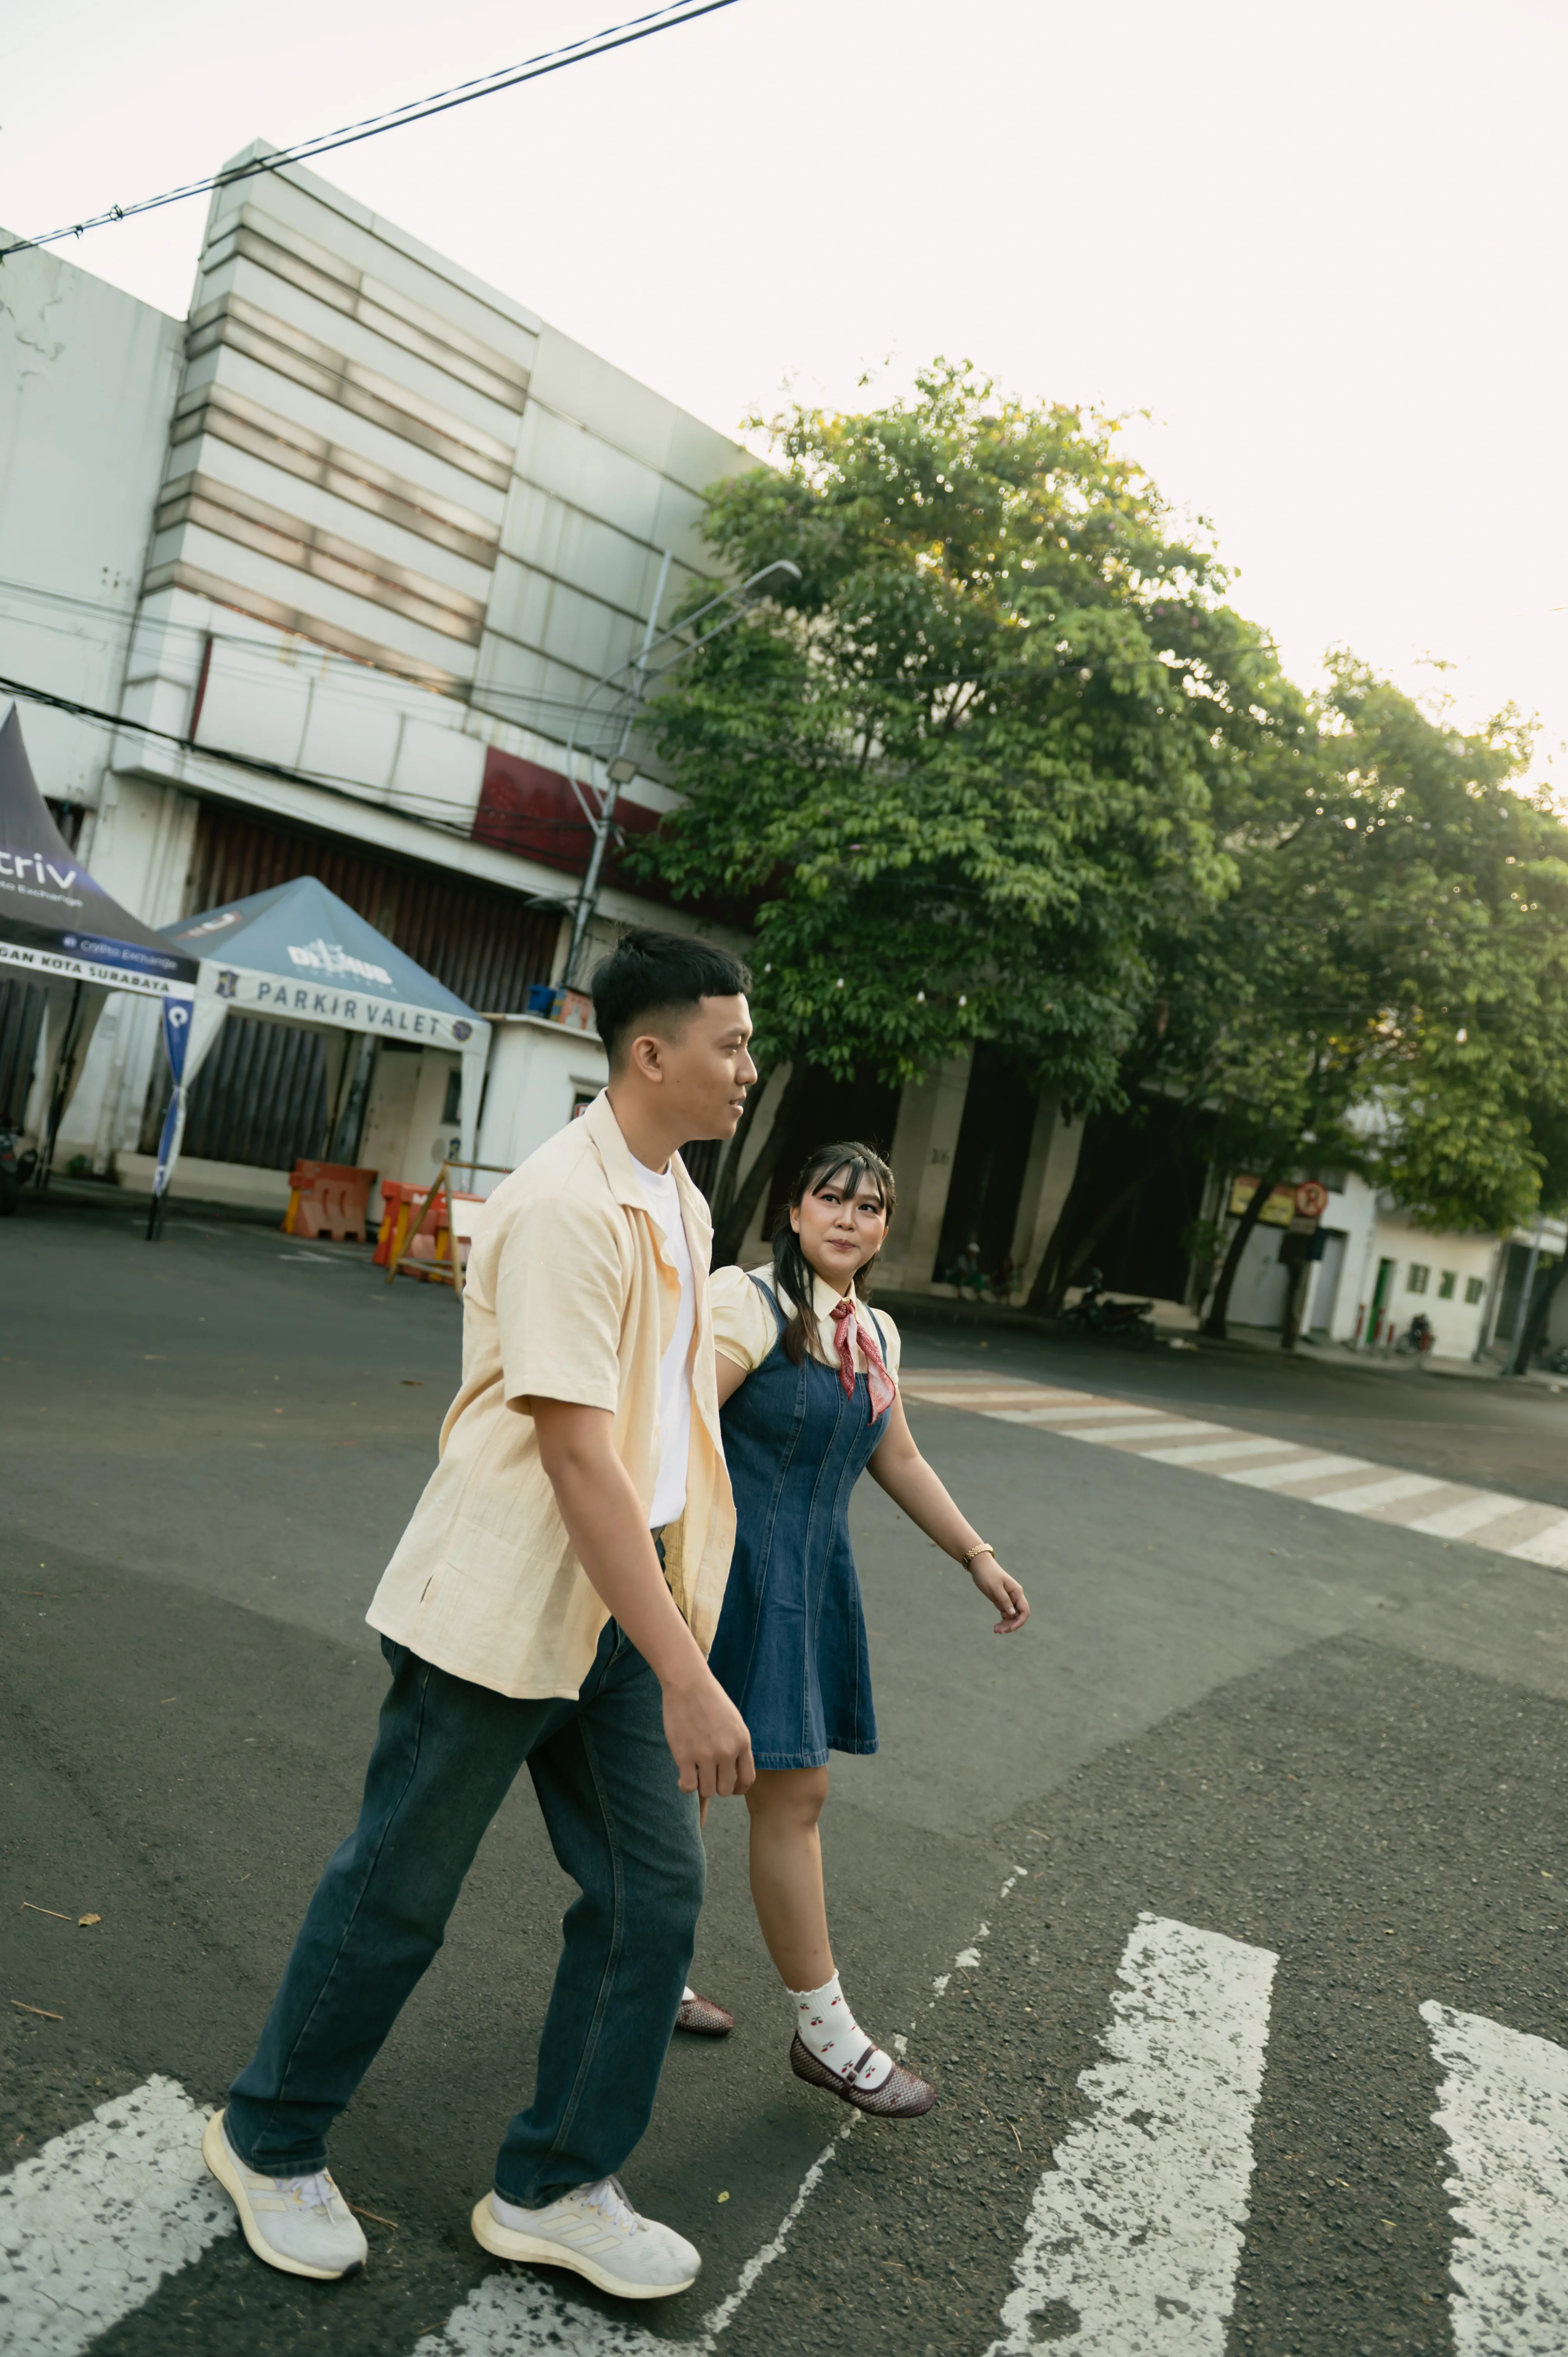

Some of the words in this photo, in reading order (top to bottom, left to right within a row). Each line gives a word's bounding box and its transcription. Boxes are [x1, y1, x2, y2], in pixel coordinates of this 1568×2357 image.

[18, 884, 84, 908] Exchange
[80, 940, 121, 958] Crypto
[122, 949, 178, 970] Exchange
[42, 956, 81, 974] KOTA
[89, 966, 170, 992] SURABAYA
[258, 982, 356, 1019] PARKIR
[367, 1004, 440, 1035] VALET
